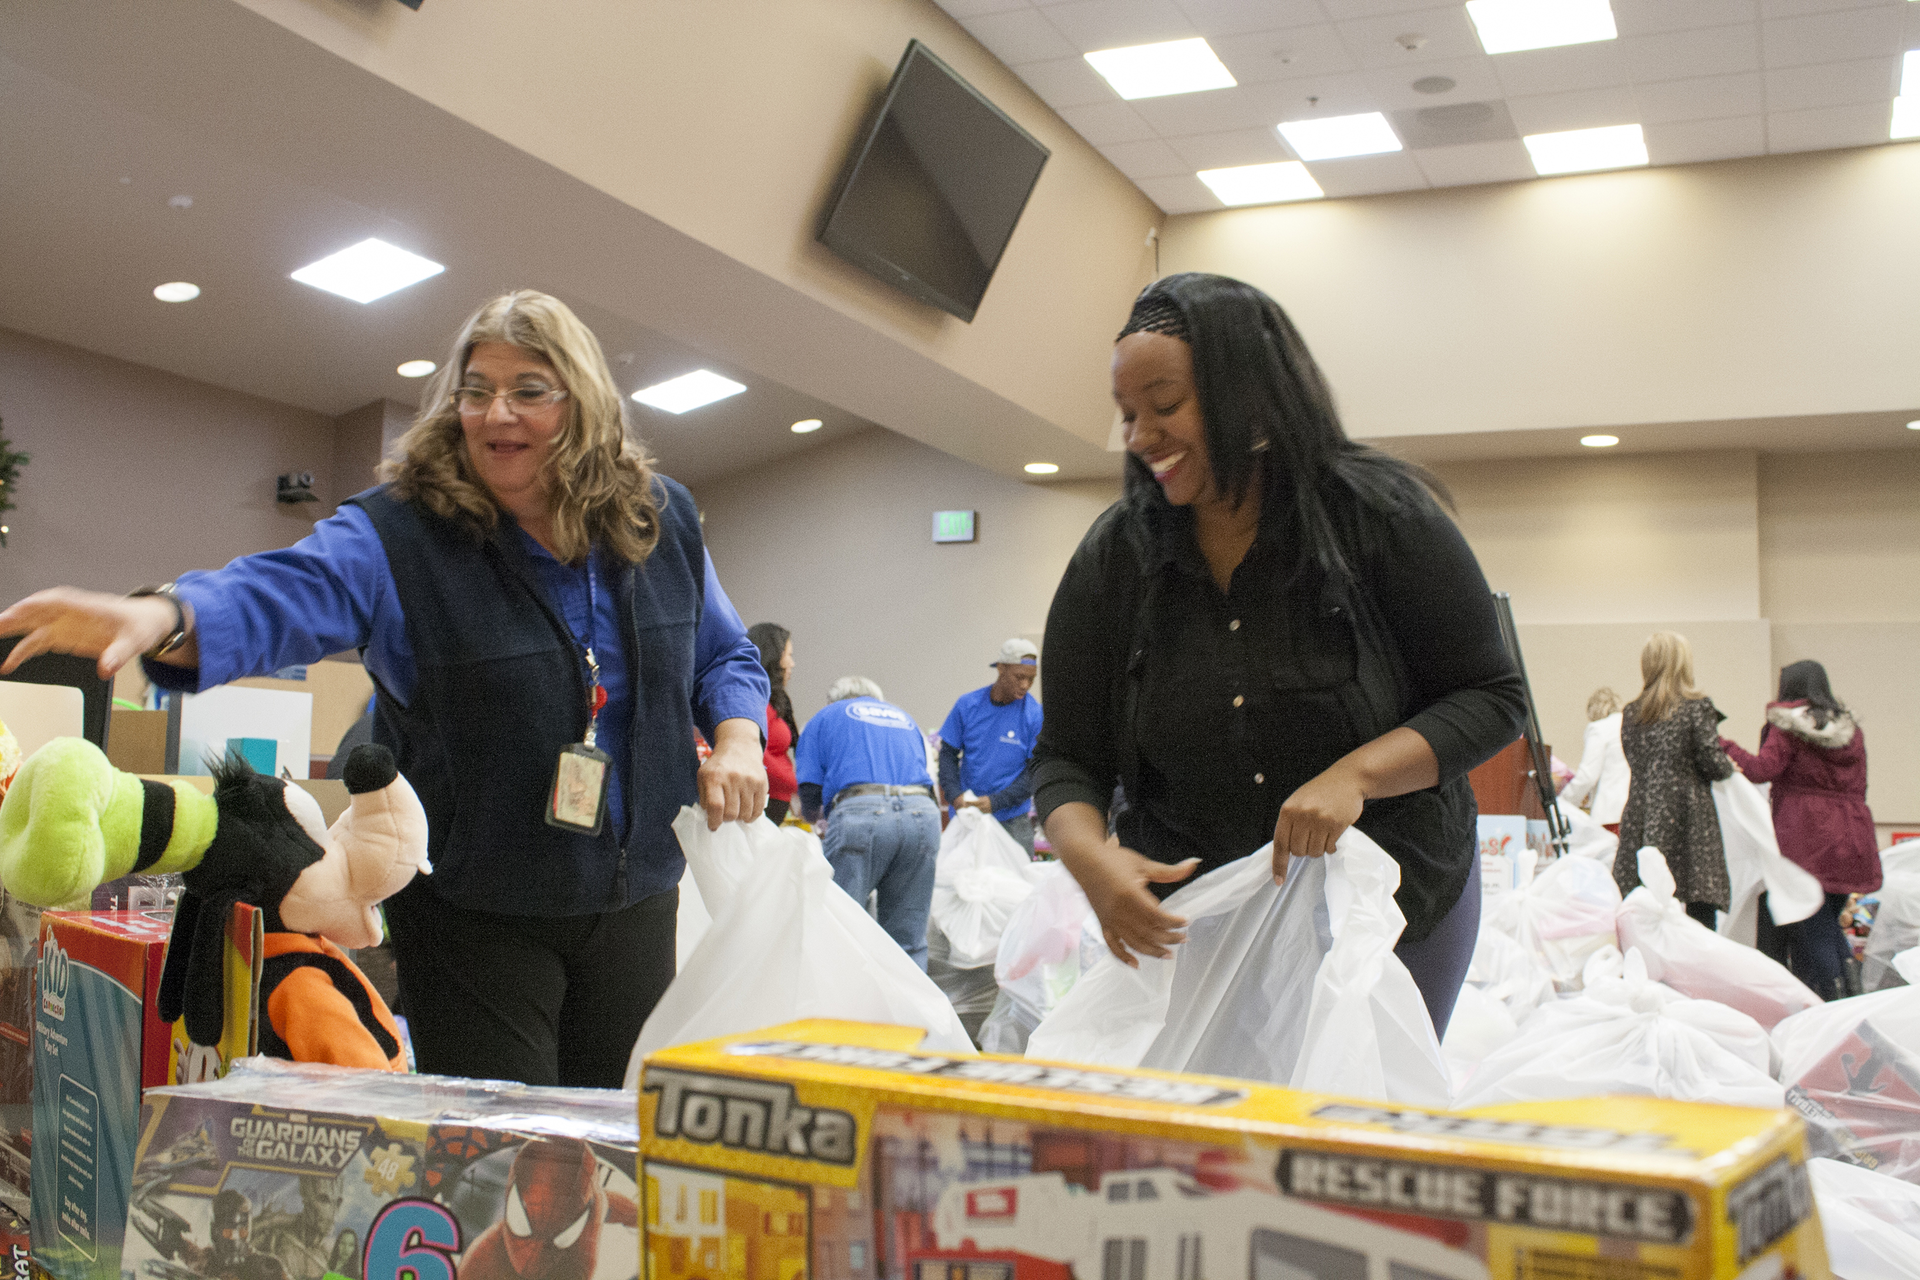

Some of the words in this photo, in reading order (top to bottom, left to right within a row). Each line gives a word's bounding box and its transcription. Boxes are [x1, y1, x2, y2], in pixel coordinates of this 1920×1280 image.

[939, 512, 968, 537] EXIT
[643, 1066, 858, 1166] Tonka
[230, 1117, 362, 1150] GUARDIANS
[255, 1140, 355, 1169] GALAXY
[377, 1158, 399, 1182] 48
[1290, 1154, 1484, 1217] RESCUE
[1496, 1179, 1677, 1240] FORCE
[363, 1197, 462, 1280] 6
